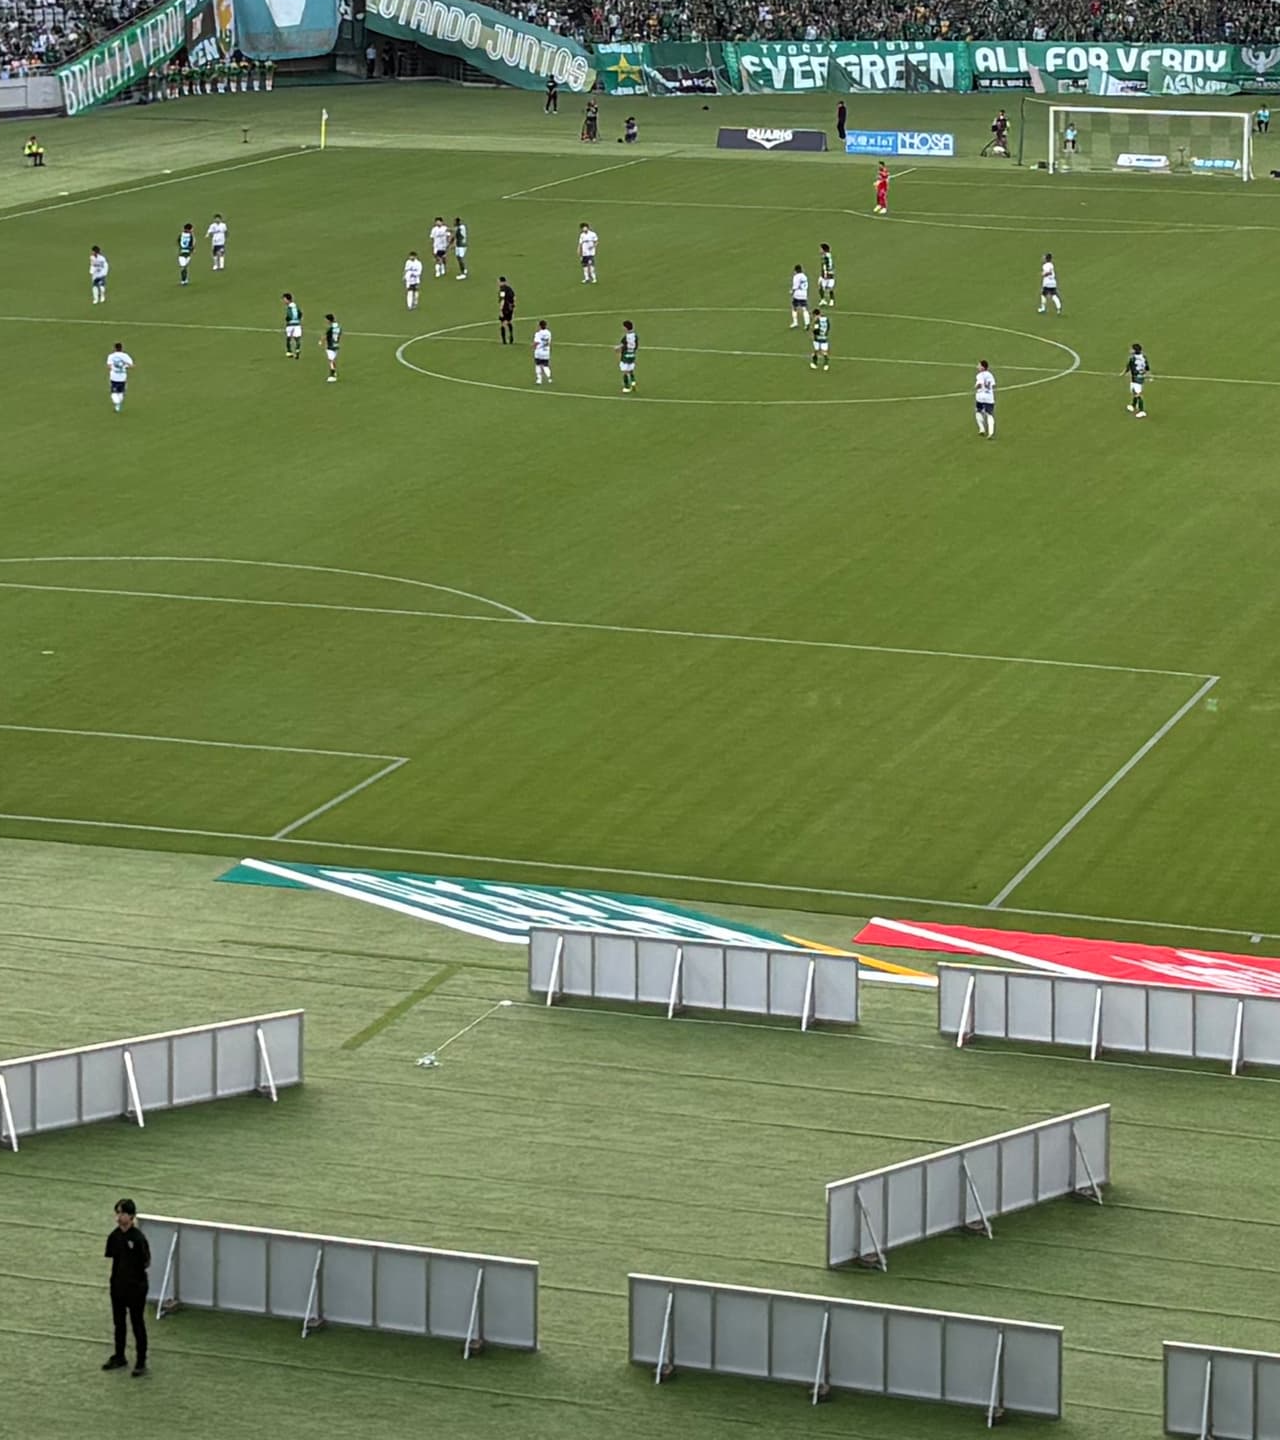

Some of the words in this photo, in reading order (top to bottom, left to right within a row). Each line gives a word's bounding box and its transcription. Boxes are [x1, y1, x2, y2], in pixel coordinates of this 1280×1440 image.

[486, 23, 588, 92] JUNTOS
[974, 47, 1029, 73] ALL
[1045, 48, 1108, 73] FOR
